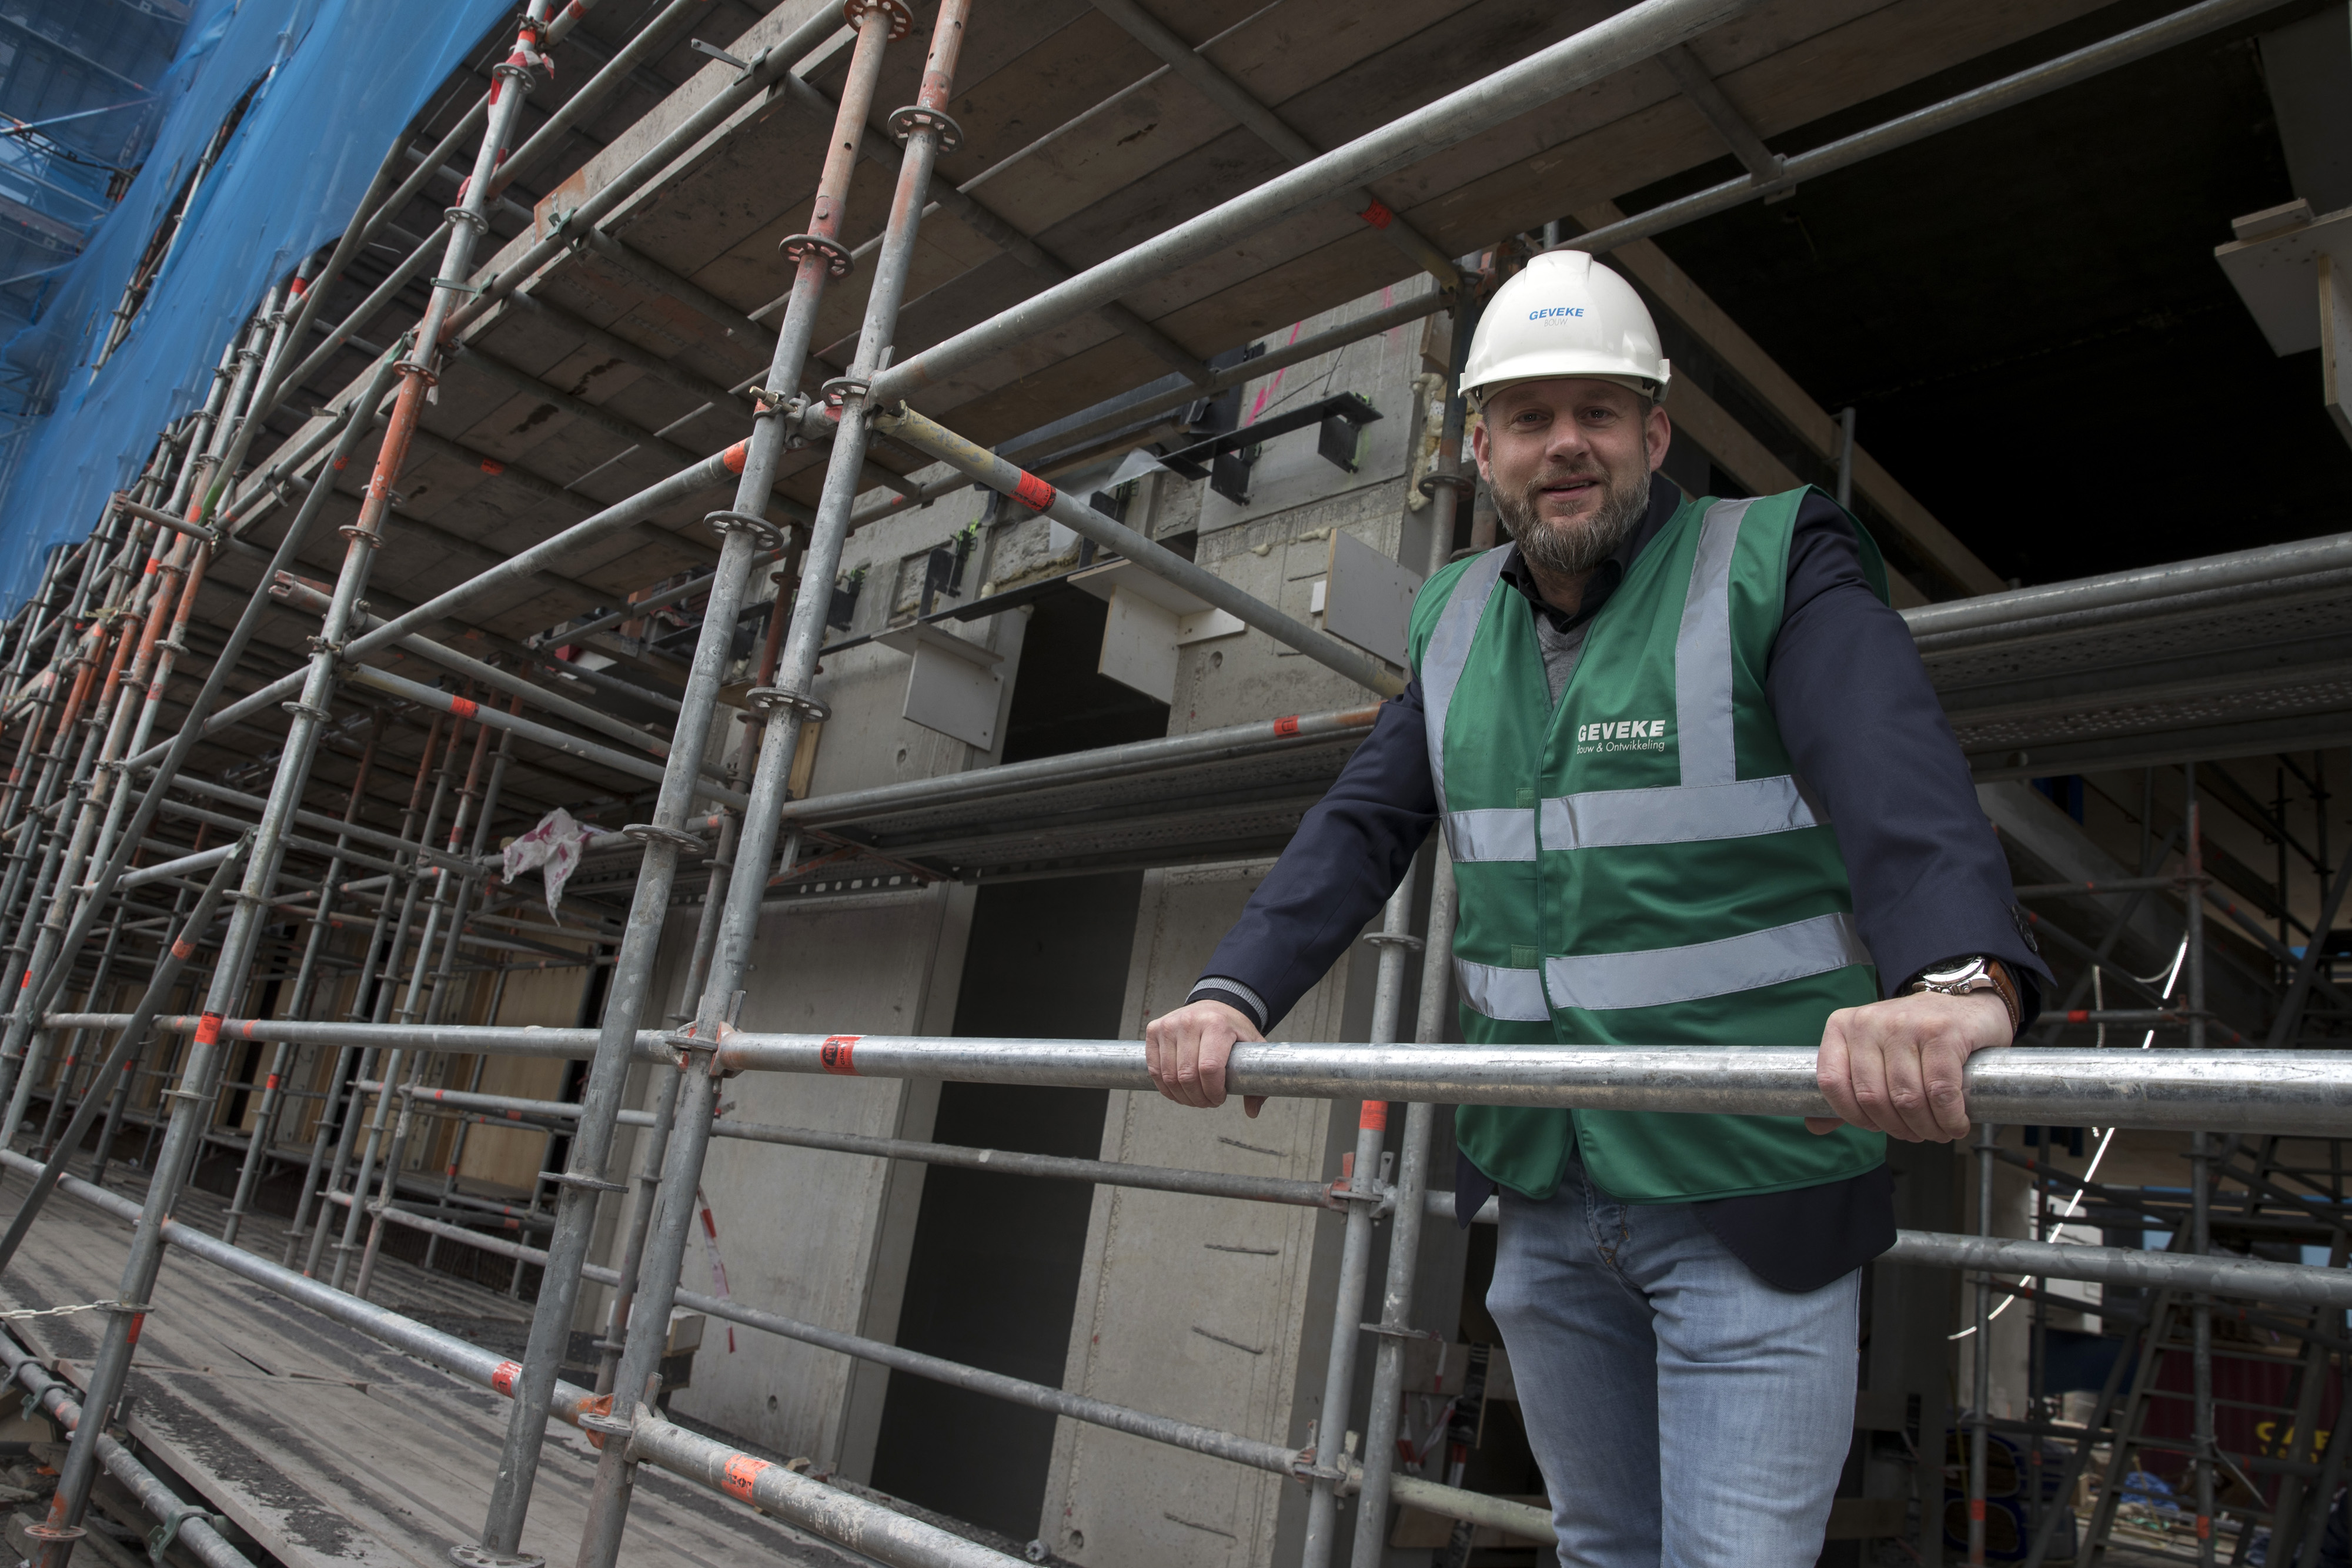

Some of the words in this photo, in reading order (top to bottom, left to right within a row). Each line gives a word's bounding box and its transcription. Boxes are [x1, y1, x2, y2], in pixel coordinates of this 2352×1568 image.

[1529, 307, 1584, 320] GEVEKE
[1544, 318, 1568, 327] BOUW
[1578, 720, 1666, 742] GEVEKE
[1576, 745, 1594, 754] Bouw
[1596, 743, 1603, 753] &
[1606, 739, 1665, 752] Ontwikkeling
